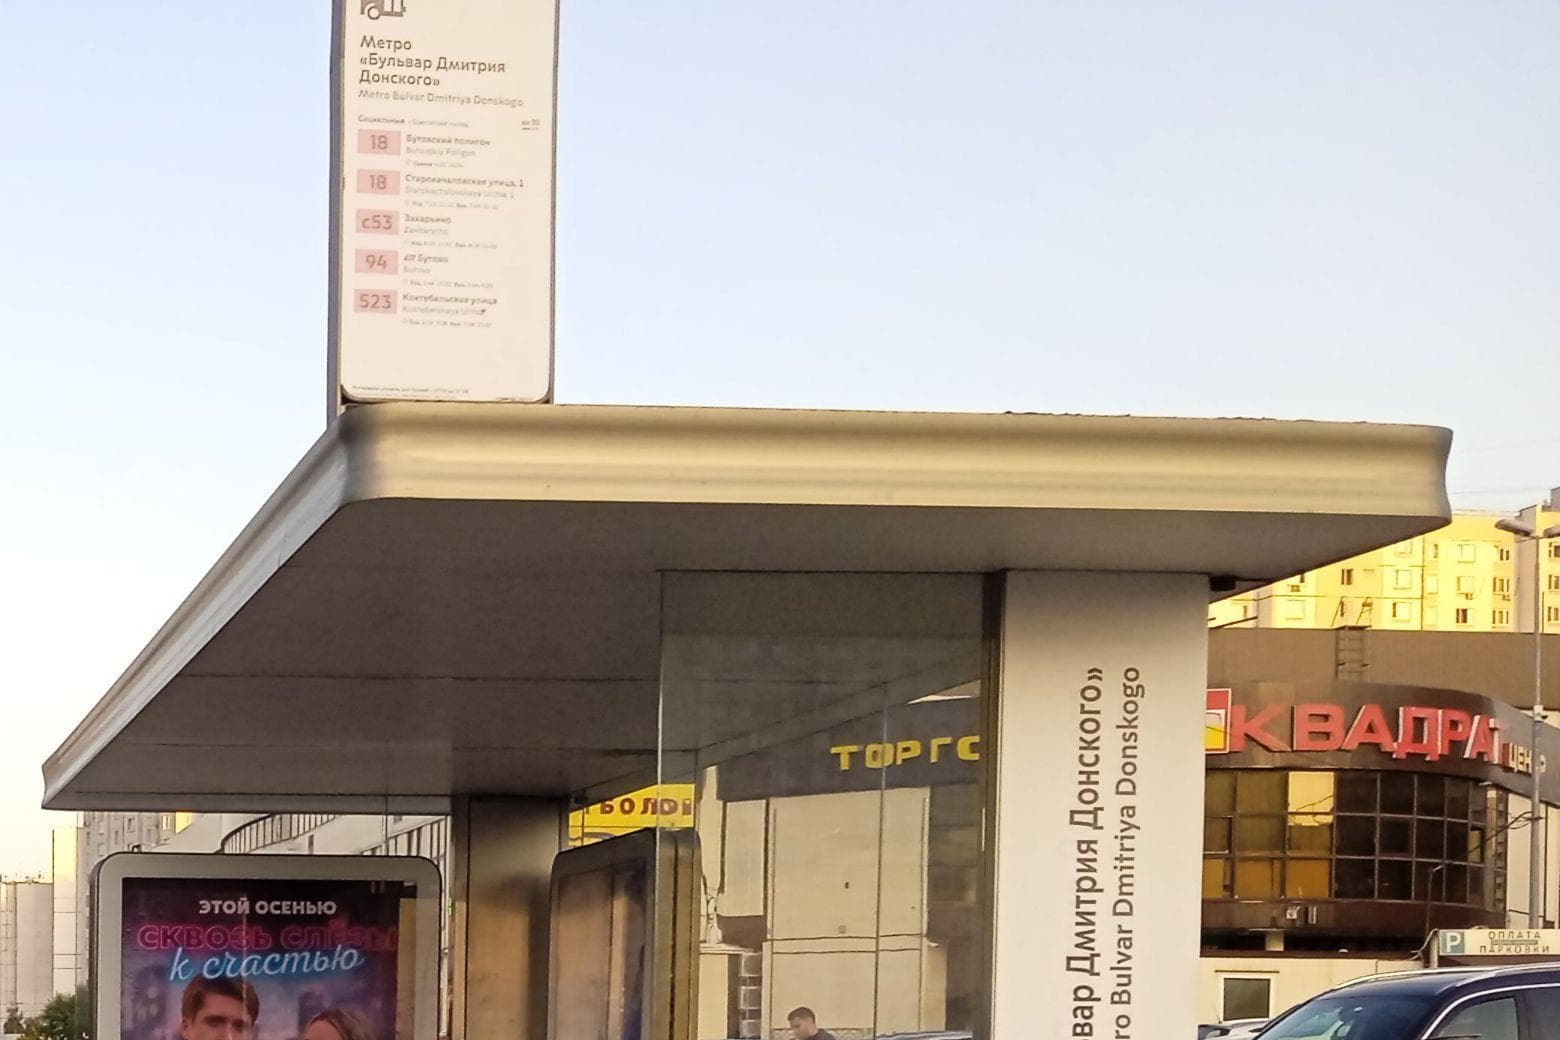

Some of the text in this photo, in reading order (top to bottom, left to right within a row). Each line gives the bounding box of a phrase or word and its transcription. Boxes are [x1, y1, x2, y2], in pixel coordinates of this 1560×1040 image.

[359, 34, 412, 52] Метро
[360, 52, 506, 75] «Бульвар Дмитрия
[358, 69, 440, 86] Донского»
[358, 89, 524, 108] Metro Bulvar Dmitriya Donskogo
[369, 134, 388, 150] 18
[369, 174, 387, 190] 18
[365, 253, 388, 270] 94
[359, 294, 392, 310] 523
[1114, 666, 1145, 796] Donskogo
[1068, 666, 1105, 831] Донского»
[1112, 804, 1141, 917] Dmitriya
[198, 898, 338, 915] ЭТОЙ ОСЕНЬЮ
[1065, 838, 1104, 977] Дмитрия
[137, 924, 272, 950] СКВОЗЬ
[1488, 931, 1541, 940] ОПЛАТА
[1480, 945, 1550, 954] ПАРКОВКИ
[202, 944, 366, 980] счастью
[1109, 923, 1134, 1005] Bulvar
